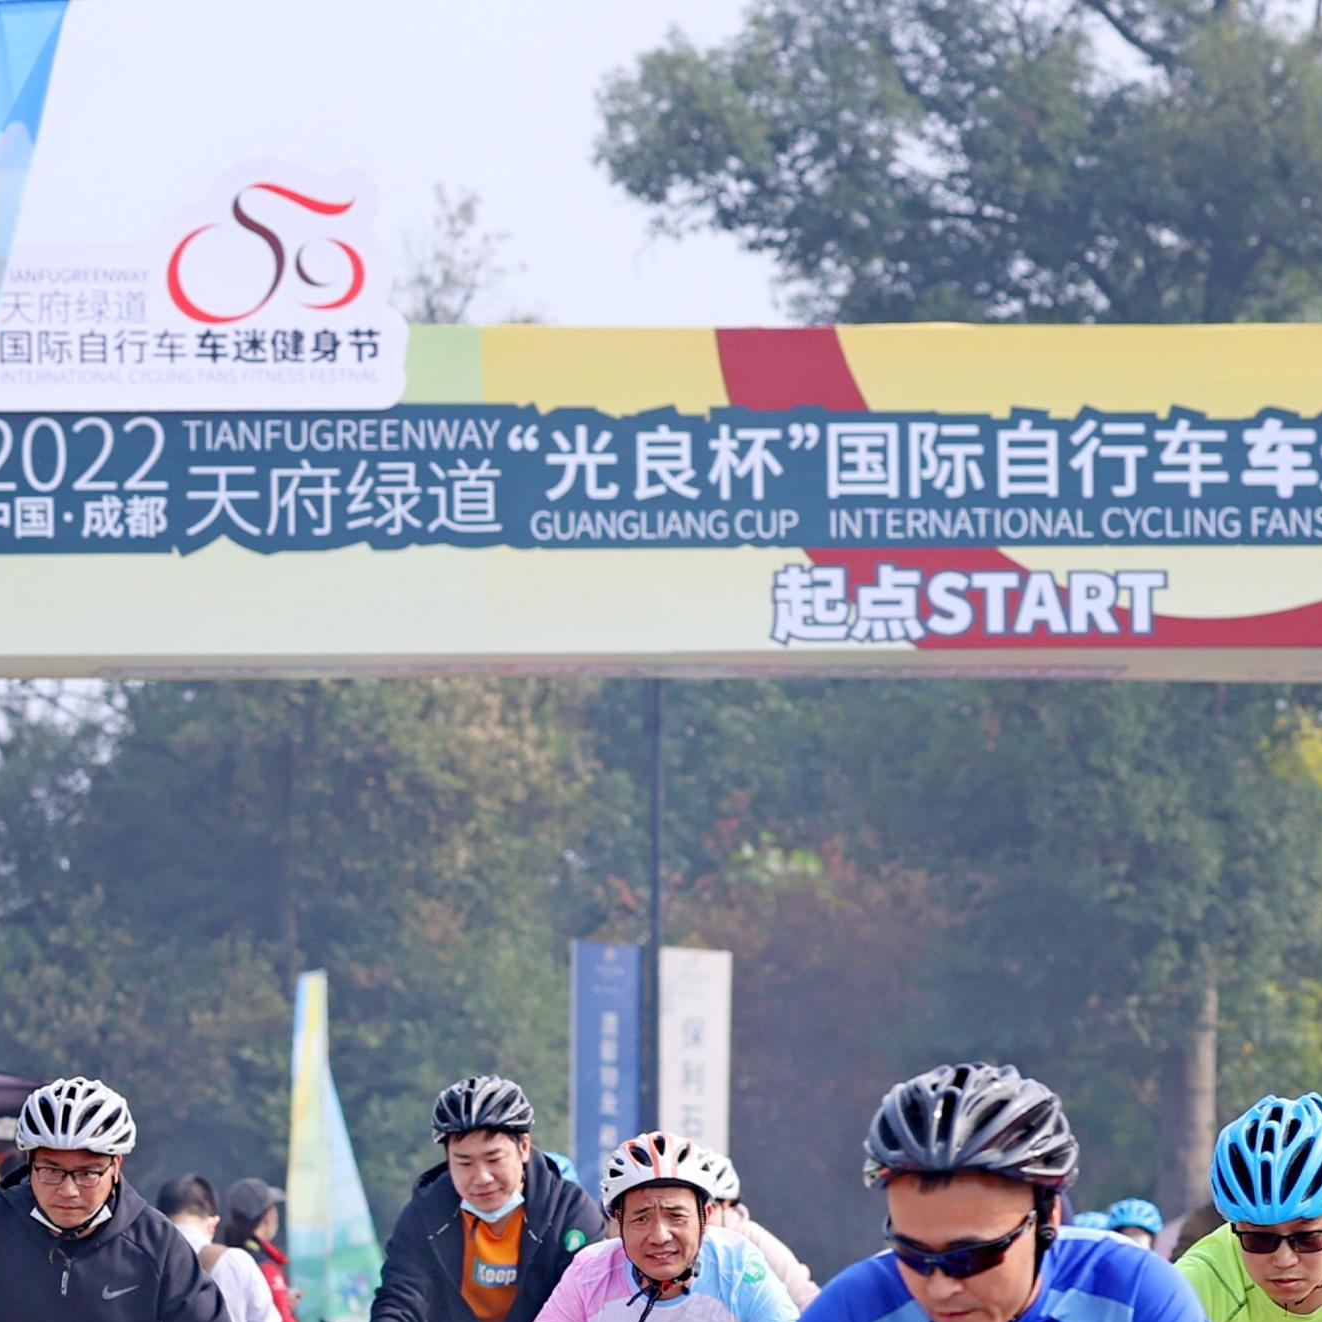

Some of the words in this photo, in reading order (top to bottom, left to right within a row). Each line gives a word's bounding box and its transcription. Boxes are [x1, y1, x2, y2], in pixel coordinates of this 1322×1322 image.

[8, 268, 149, 284] IANFUGREENWAY
[1, 289, 149, 326] 天府绿道
[185, 418, 501, 454] TIANFUGREENWAY
[185, 459, 503, 538] 天府绿道
[530, 508, 732, 542] GUANGLIANG
[734, 508, 800, 541] CUP
[830, 507, 1093, 540] INTERNATIONAL
[1101, 506, 1242, 541] CYCLING
[477, 1262, 517, 1286] Keep
